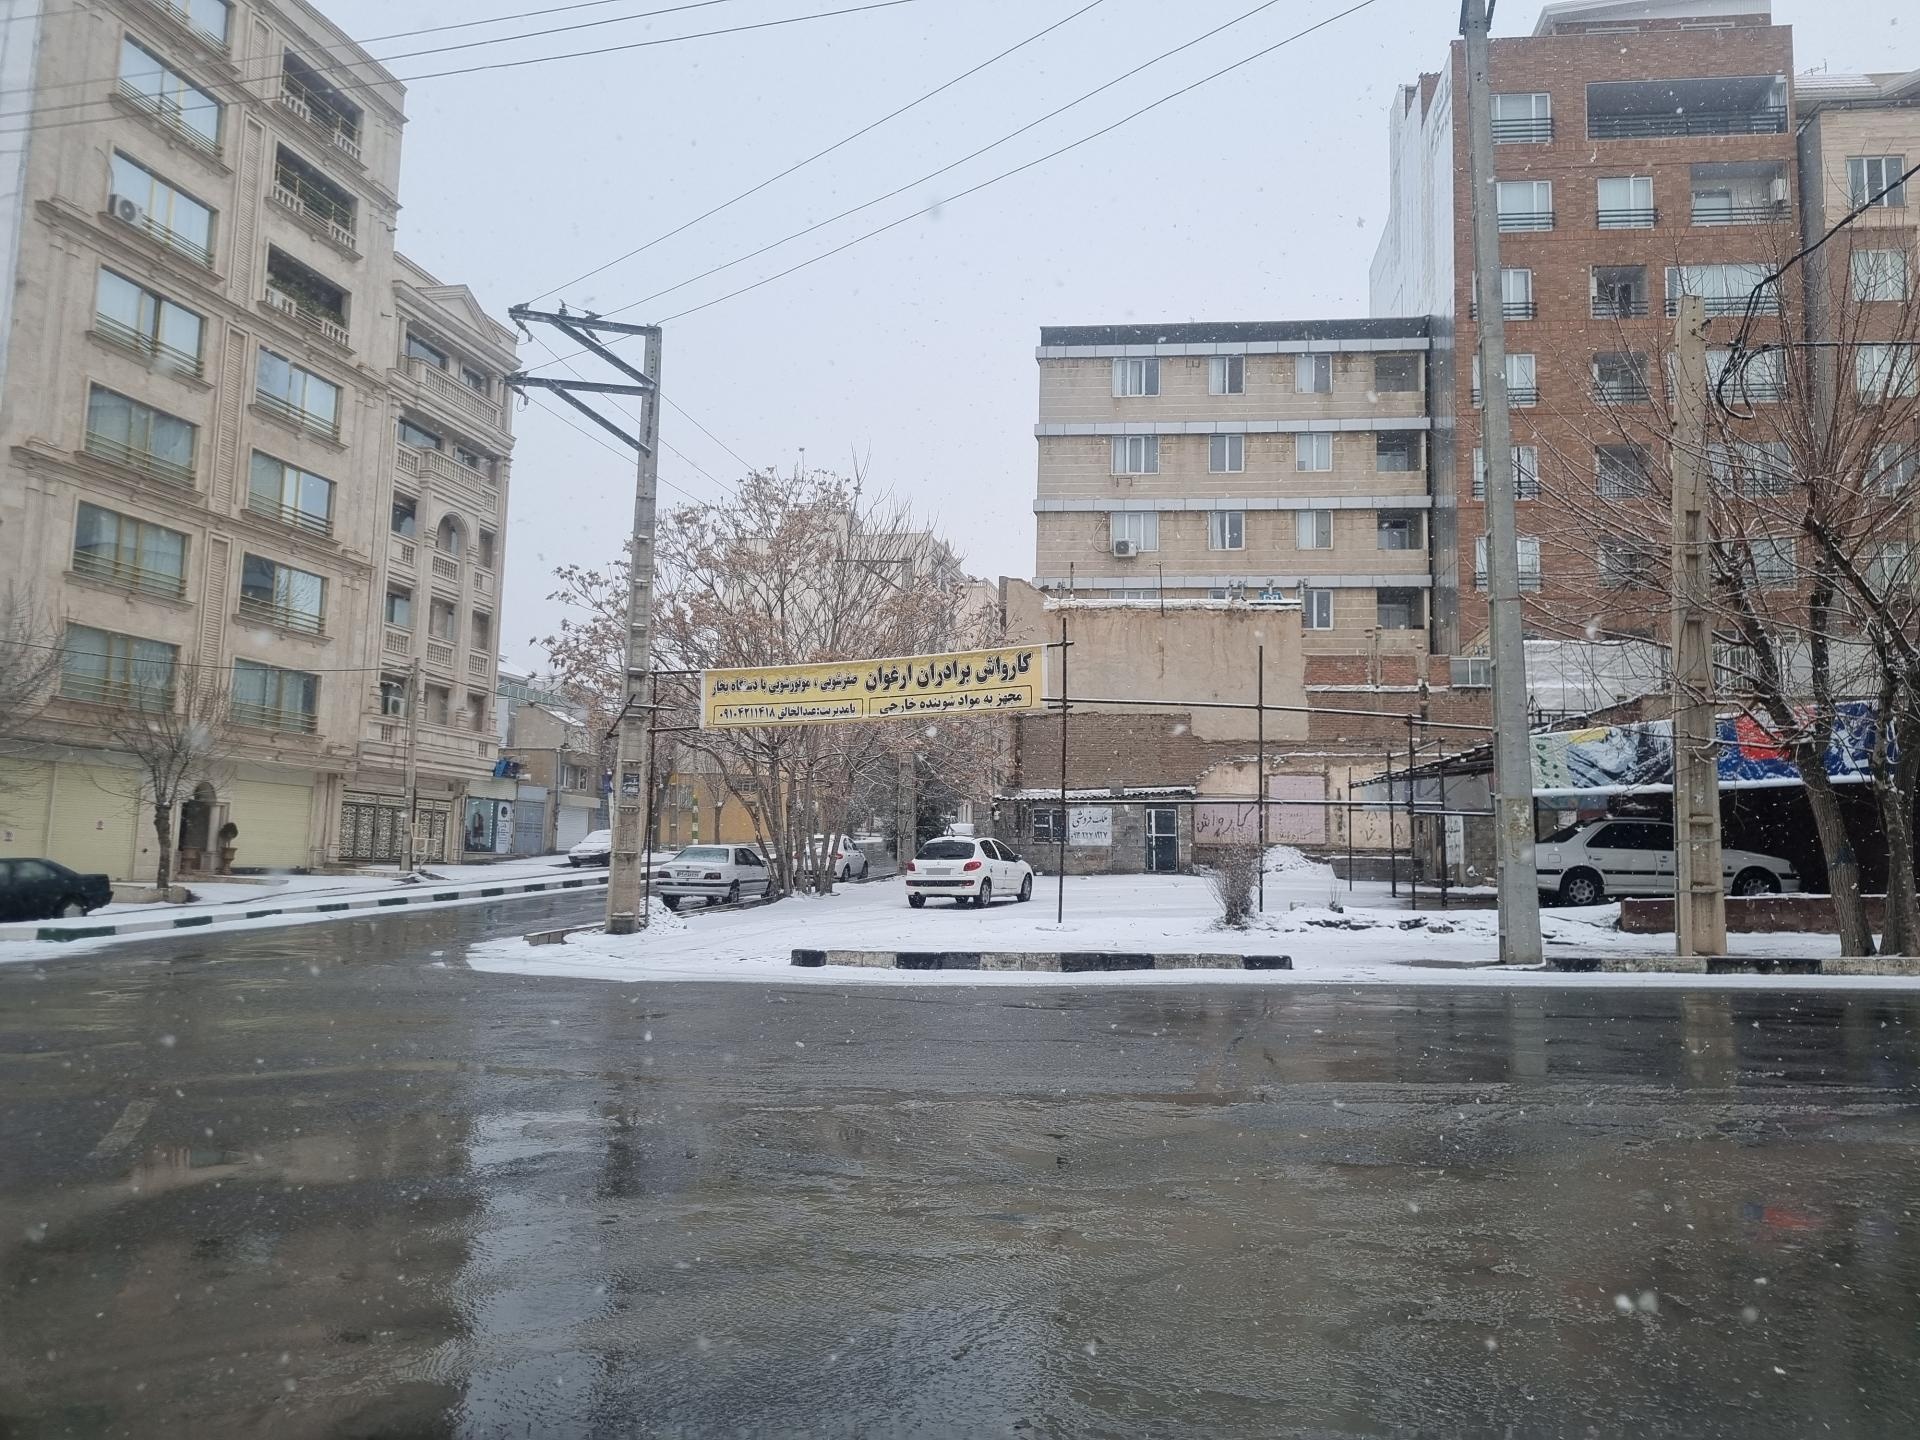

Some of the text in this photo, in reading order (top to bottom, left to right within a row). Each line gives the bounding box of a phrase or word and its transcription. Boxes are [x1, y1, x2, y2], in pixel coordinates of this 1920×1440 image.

[865, 651, 1033, 692] کارواش برادران ارغوان
[712, 680, 729, 696] بخار
[760, 678, 767, 693] با
[880, 692, 1022, 714] مجهز به مواد شوینده خارجی
